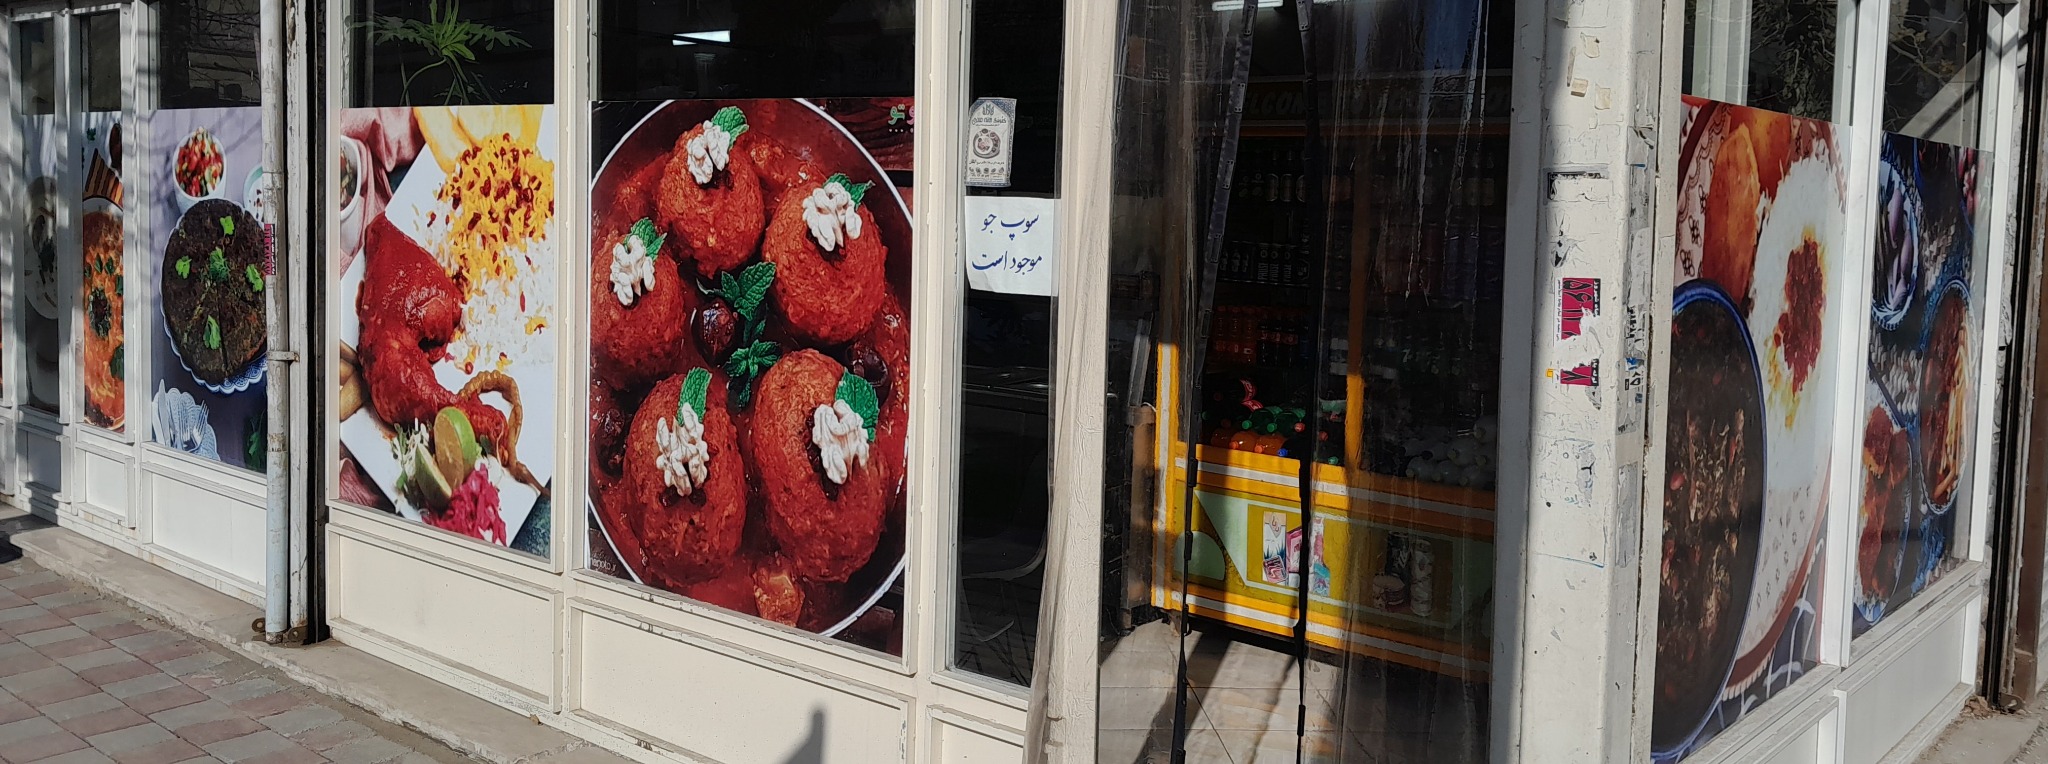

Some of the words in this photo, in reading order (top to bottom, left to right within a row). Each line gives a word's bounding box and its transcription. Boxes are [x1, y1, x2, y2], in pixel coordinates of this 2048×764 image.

[981, 212, 997, 234] جو
[1000, 213, 1040, 241] سوپ
[971, 251, 1008, 271] است
[1009, 256, 1042, 276] موجود
